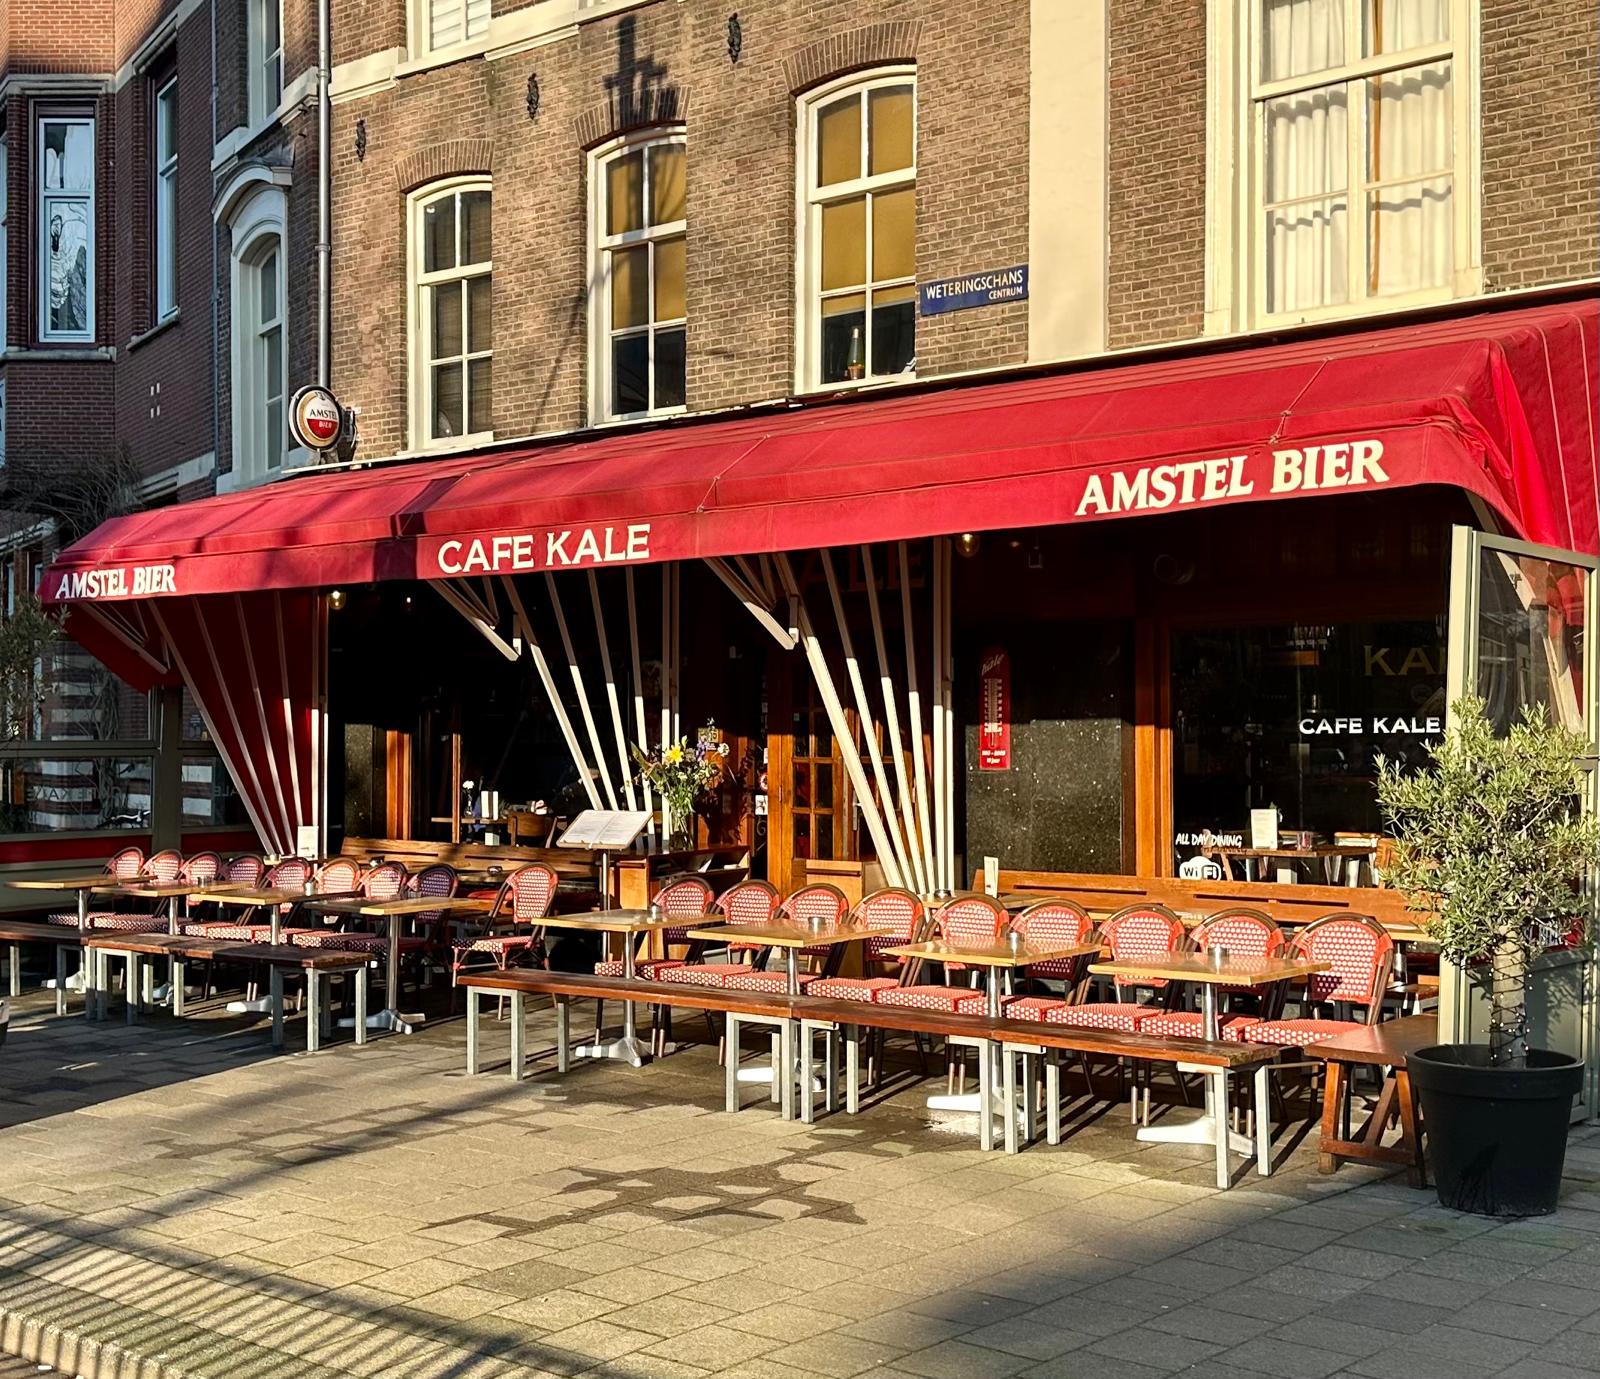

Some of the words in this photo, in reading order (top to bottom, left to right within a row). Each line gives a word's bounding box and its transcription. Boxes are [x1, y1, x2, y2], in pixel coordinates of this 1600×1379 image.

[925, 269, 1024, 301] WETERINGSCHANS
[988, 285, 1023, 301] CENTRUM
[309, 408, 338, 420] AMSTEL
[318, 420, 332, 429] BIER
[1075, 454, 1255, 517] AMSTEL
[1269, 439, 1390, 494] BIER
[437, 534, 535, 575] CAFE
[545, 523, 651, 567] KALE
[55, 568, 129, 600] AMSTEL
[131, 564, 176, 596] BIER
[1299, 717, 1364, 735] CAFE
[1373, 717, 1442, 735] KALE
[1175, 832, 1190, 845] ALL
[1191, 833, 1210, 846] DAY
[1211, 834, 1243, 848] DINING
